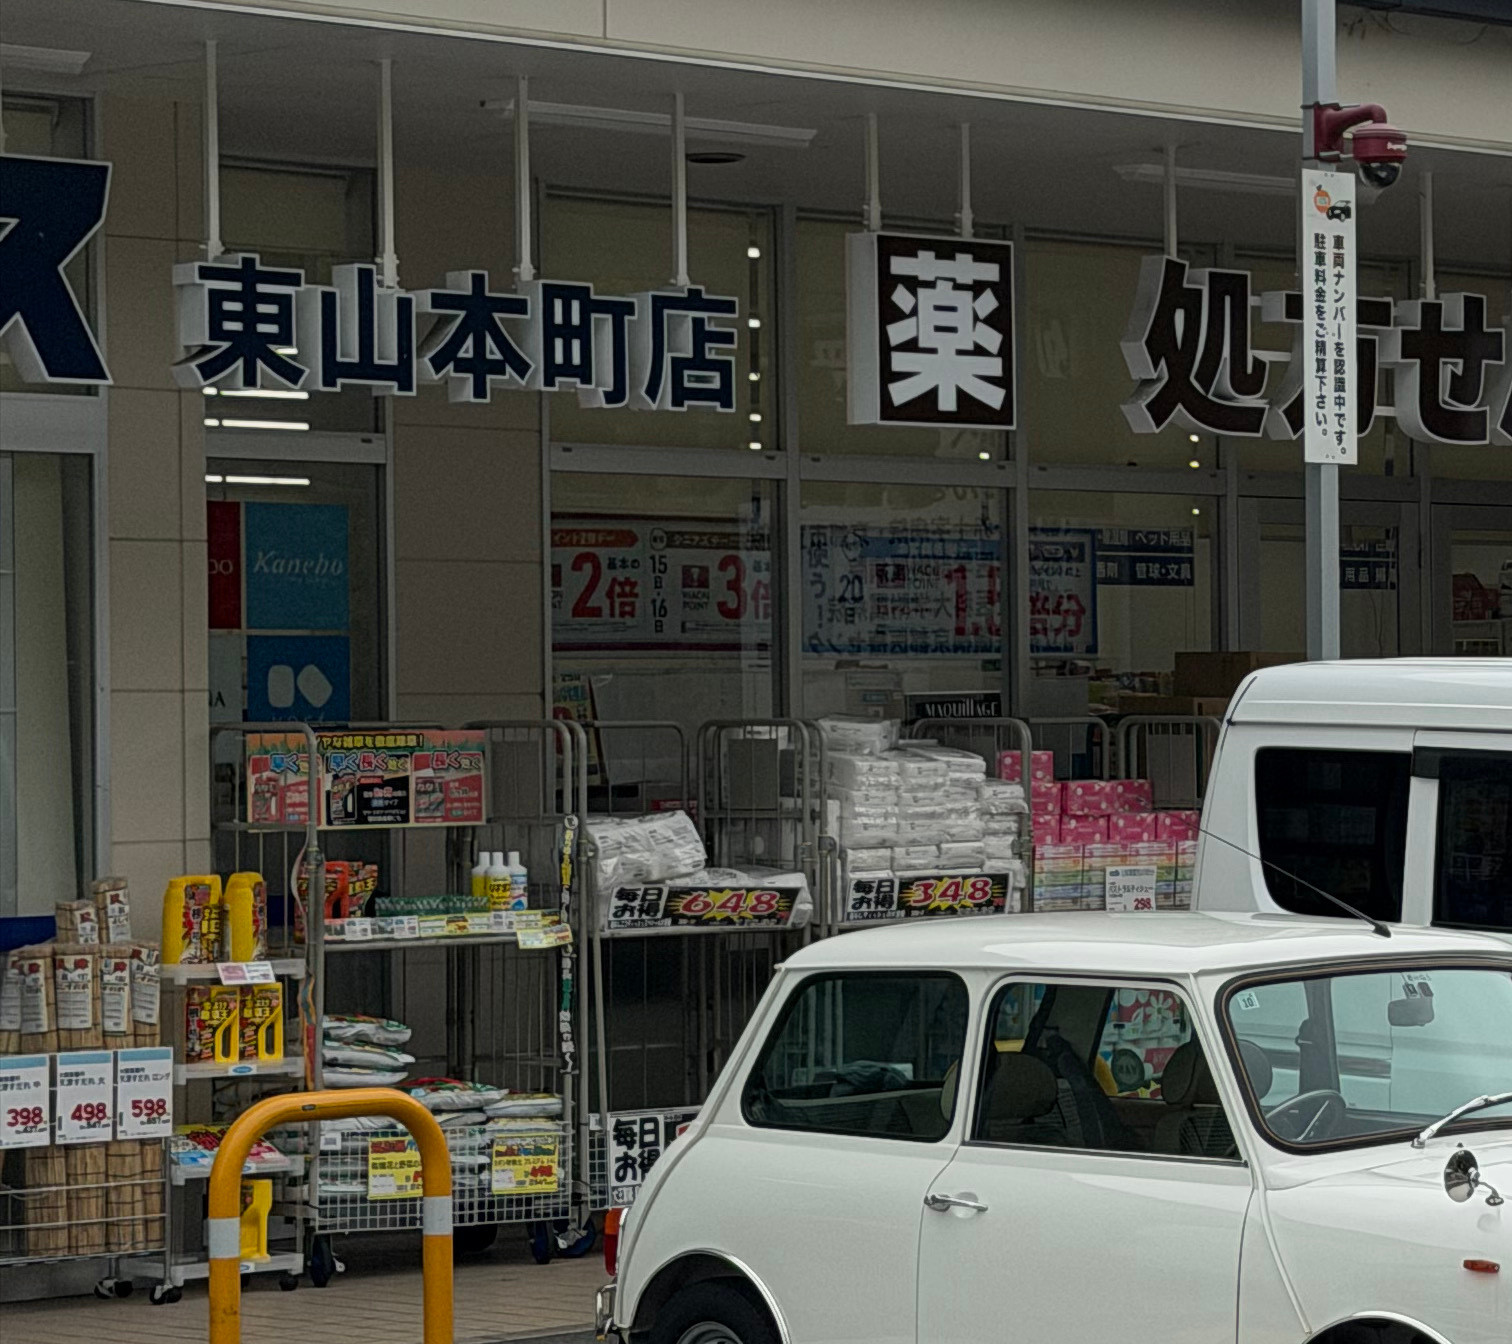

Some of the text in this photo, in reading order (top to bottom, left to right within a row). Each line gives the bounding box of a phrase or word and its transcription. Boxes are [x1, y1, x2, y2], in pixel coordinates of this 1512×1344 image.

[196, 256, 738, 412] 東山本町店
[886, 250, 1006, 412] 薬
[253, 551, 344, 577] Kanebo
[853, 879, 895, 895] 毎日
[911, 877, 993, 906] 348
[680, 890, 780, 916] 648
[6, 1106, 44, 1127] 398
[70, 1102, 107, 1122] 498
[131, 1098, 167, 1118] 598
[613, 1116, 660, 1151] 毎日
